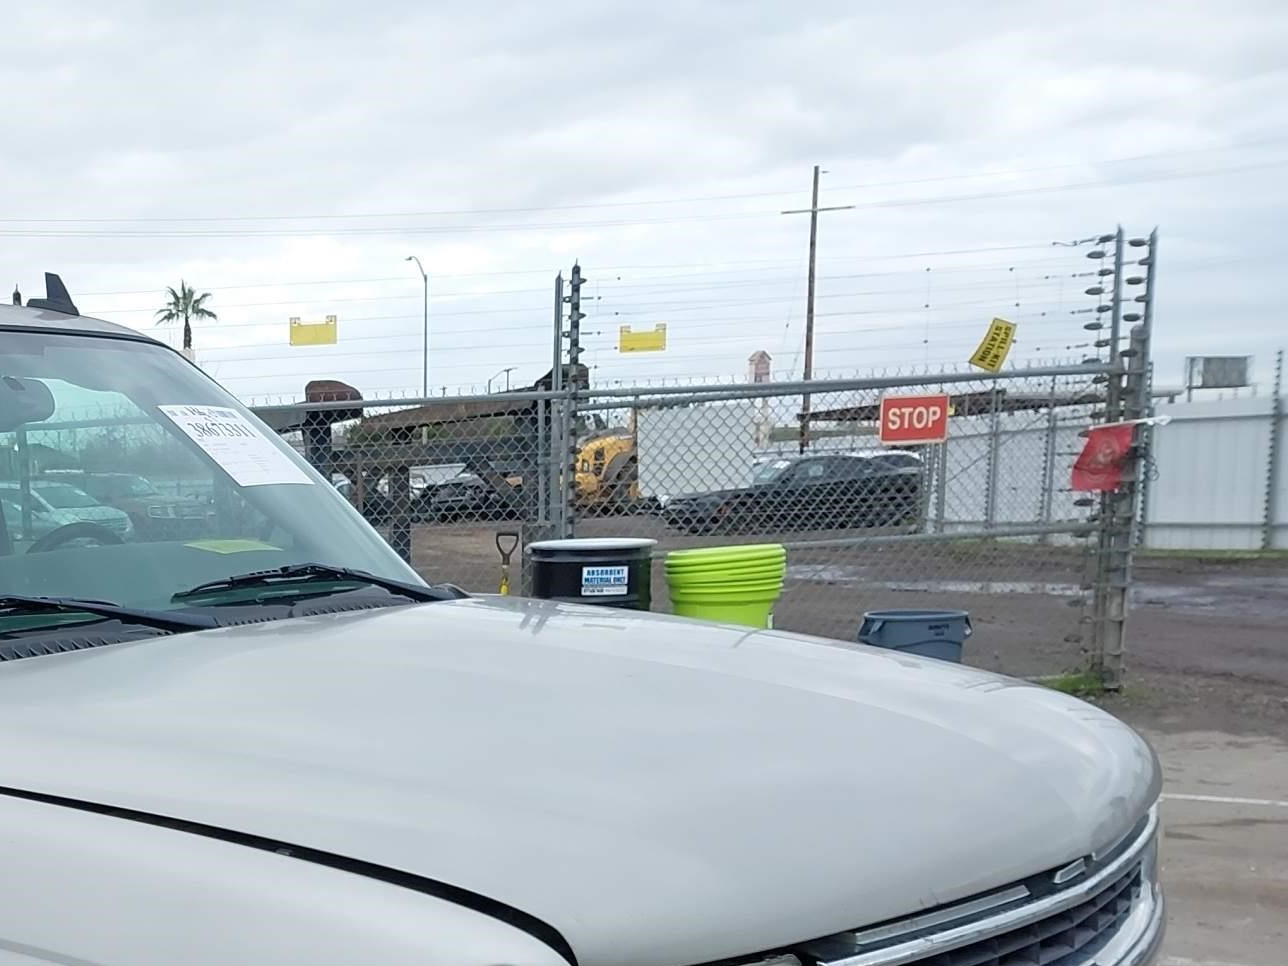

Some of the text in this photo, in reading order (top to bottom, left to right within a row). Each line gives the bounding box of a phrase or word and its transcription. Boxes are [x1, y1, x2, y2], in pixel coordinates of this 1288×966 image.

[978, 326, 1003, 362] STATION
[987, 354, 1001, 368] KIT
[888, 406, 941, 430] STOP
[186, 421, 258, 438] 38673311
[584, 576, 612, 584] MATERIAL
[586, 568, 625, 577] ABSORBENT
